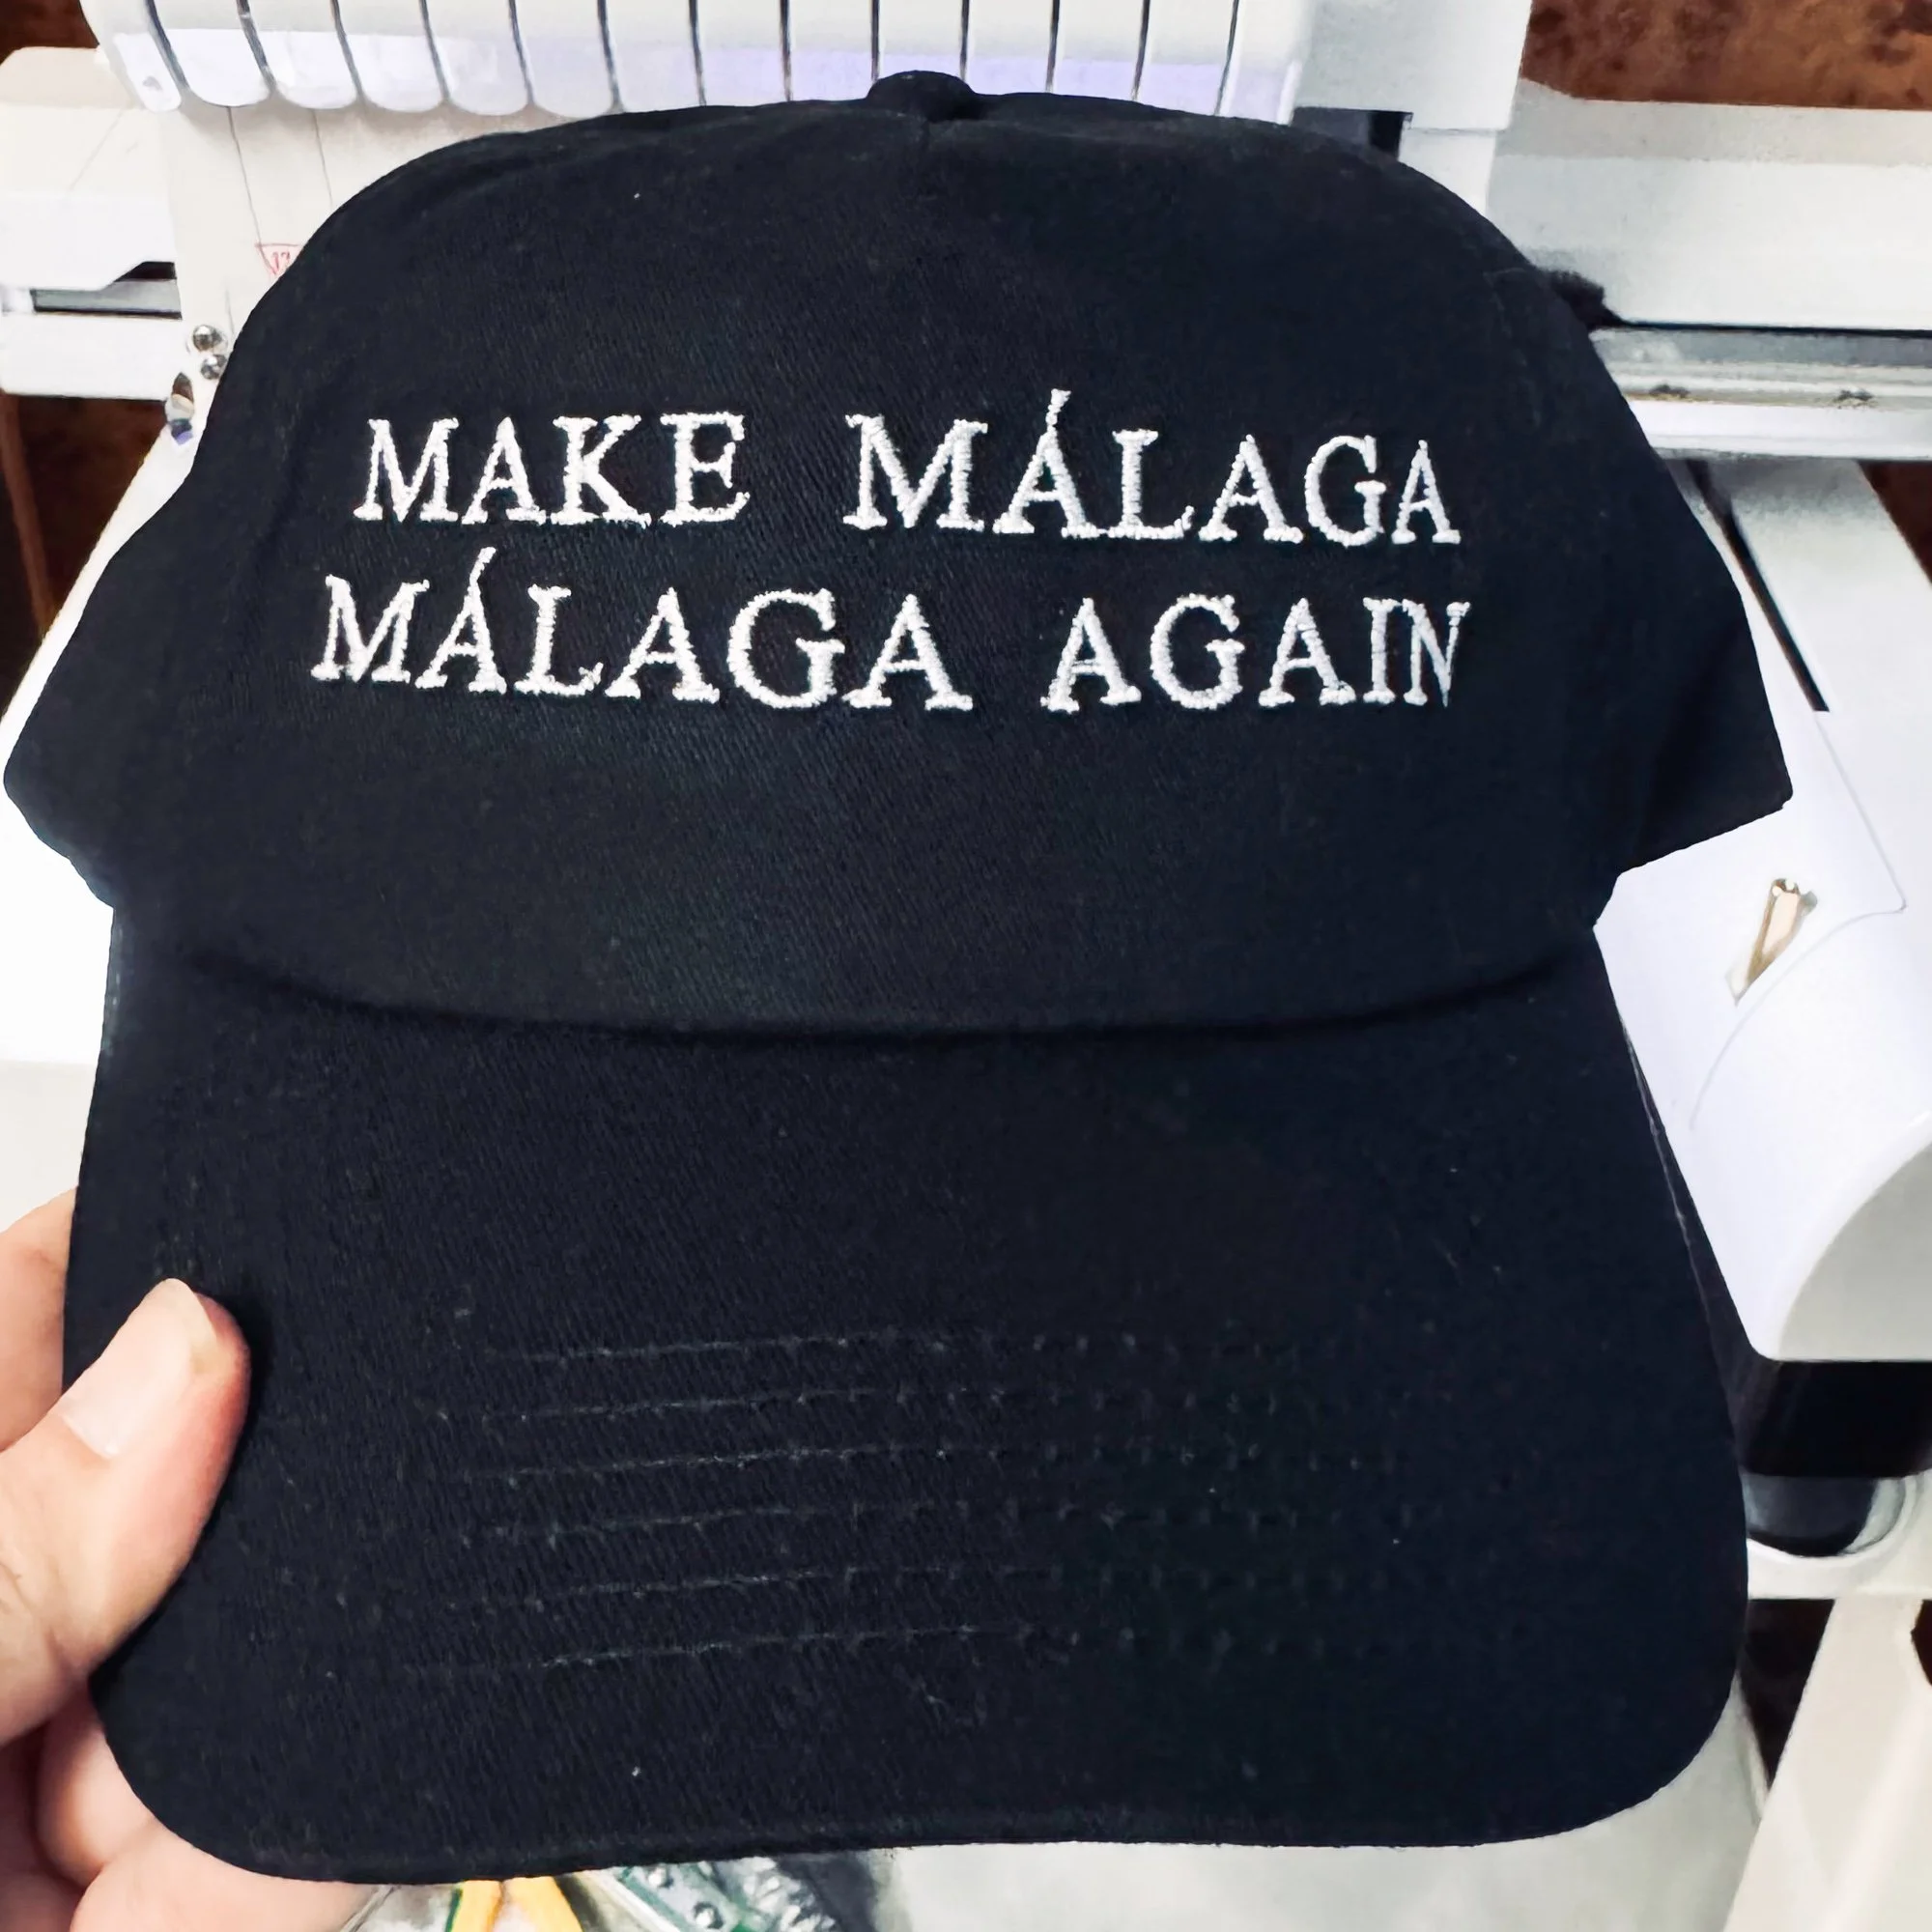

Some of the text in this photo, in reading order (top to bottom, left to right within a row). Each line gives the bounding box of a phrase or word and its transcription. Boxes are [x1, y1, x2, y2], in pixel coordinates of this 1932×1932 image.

[354, 388, 1462, 549] MAKE MÁLAGA
[311, 547, 1471, 715] MÁLAGA AGAIN
